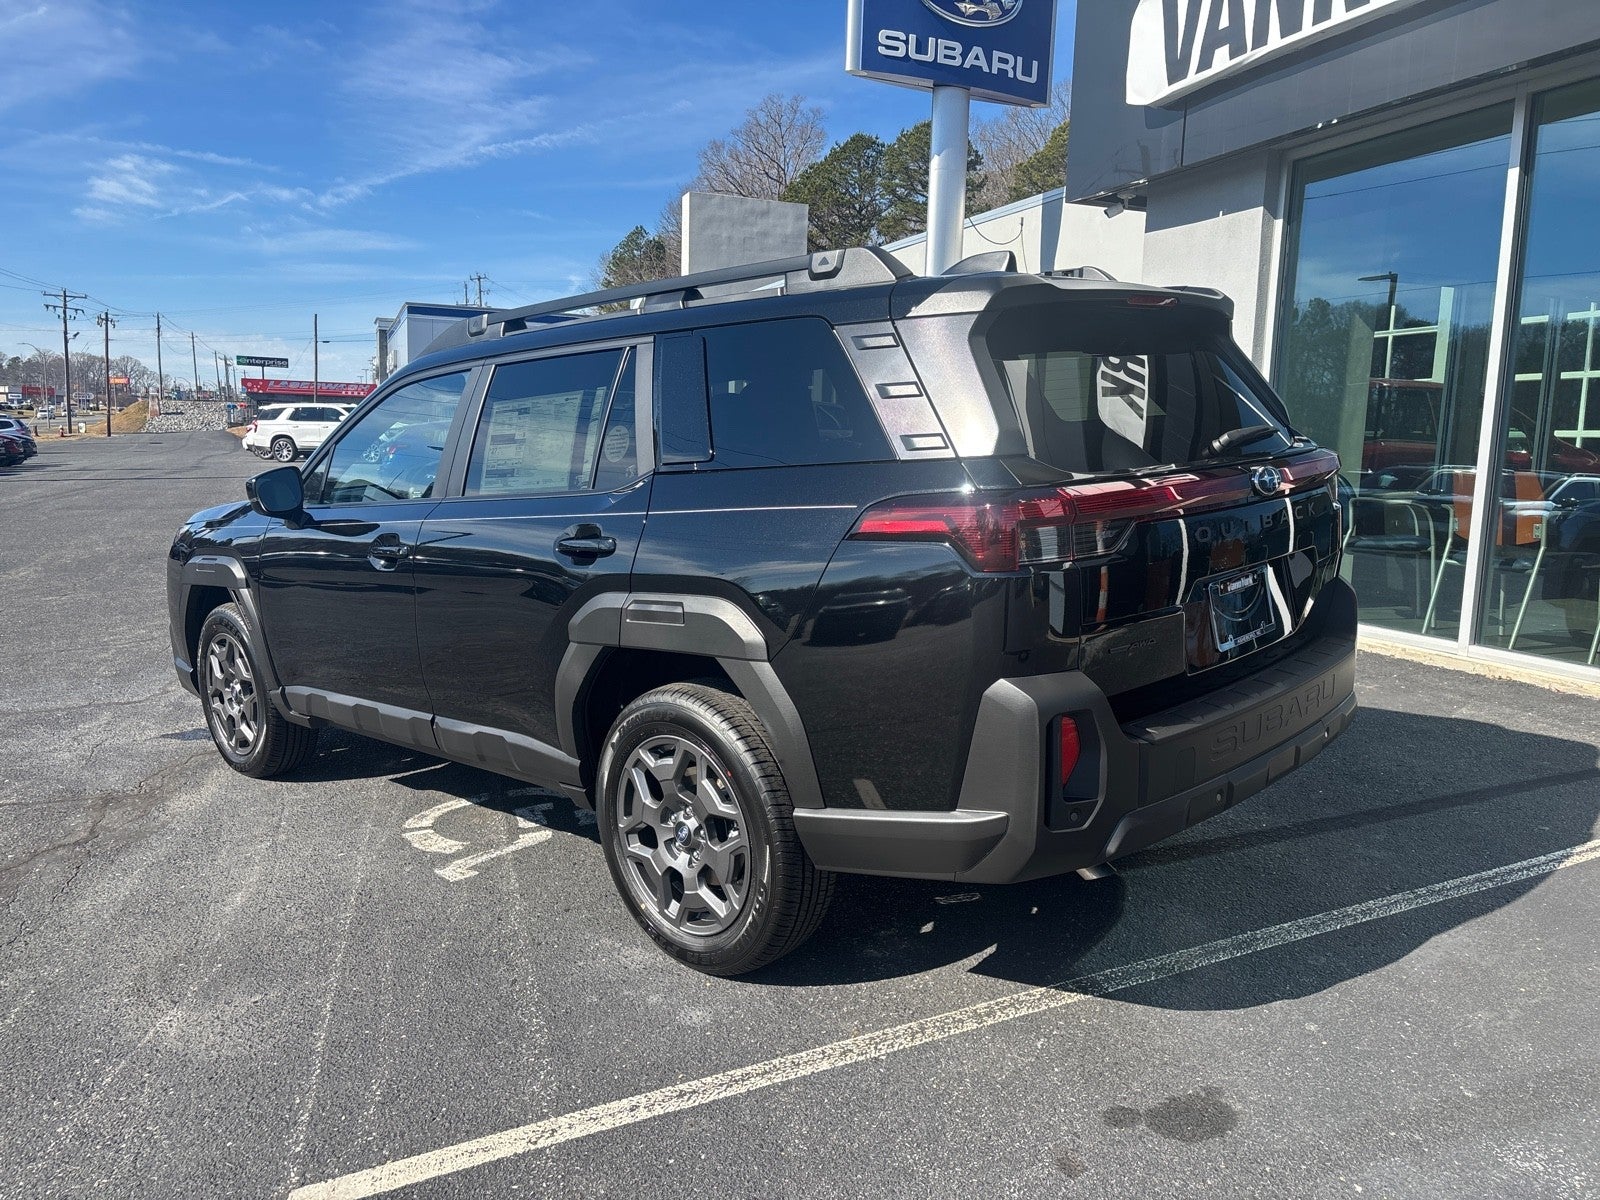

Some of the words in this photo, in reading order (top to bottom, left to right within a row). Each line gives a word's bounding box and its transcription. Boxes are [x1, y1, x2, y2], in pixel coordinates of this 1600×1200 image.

[878, 29, 1038, 84] SUBARU
[240, 357, 288, 367] enterprise
[1194, 502, 1316, 542] OUTBACK
[1210, 673, 1336, 761] SUBARU
